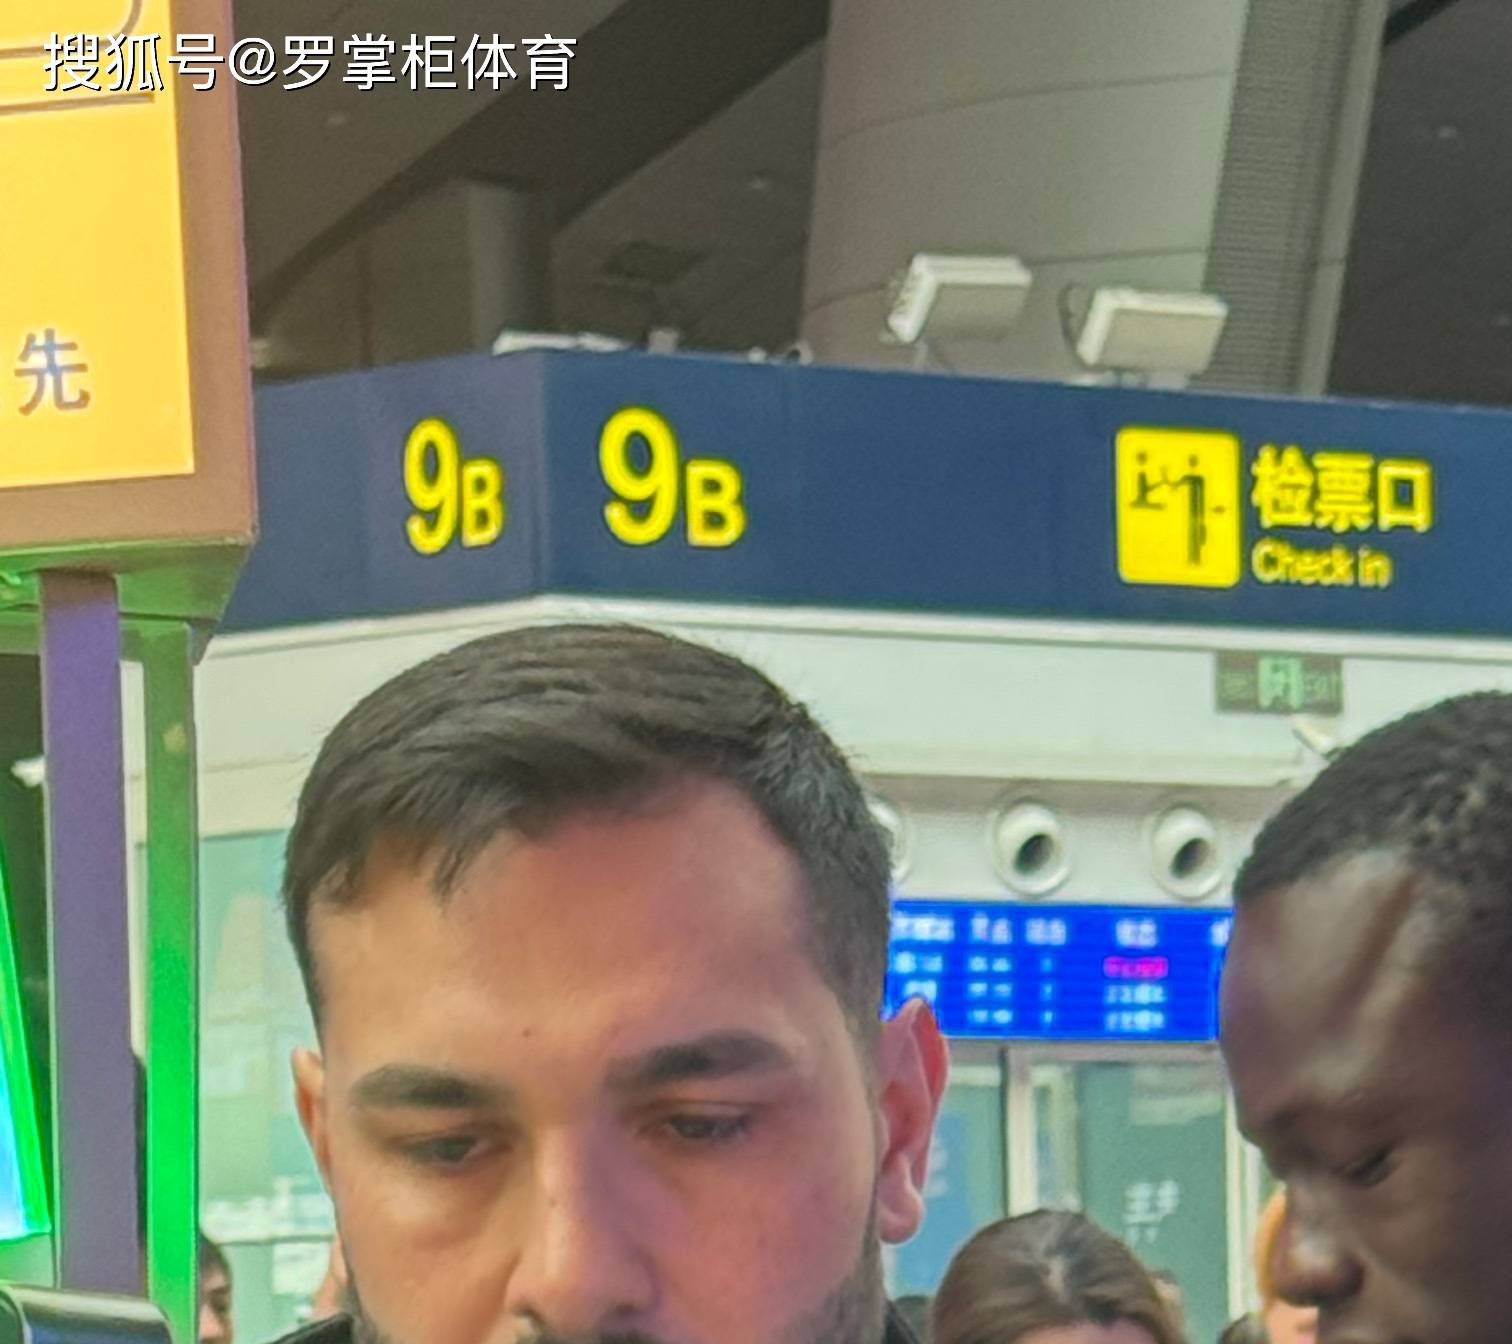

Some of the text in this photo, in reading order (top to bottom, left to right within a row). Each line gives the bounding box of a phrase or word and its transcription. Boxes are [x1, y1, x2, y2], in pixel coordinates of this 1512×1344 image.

[403, 418, 503, 554] 9B
[599, 407, 746, 547] 9B
[1251, 444, 1434, 534] 检票口
[1251, 538, 1393, 588] Check in
